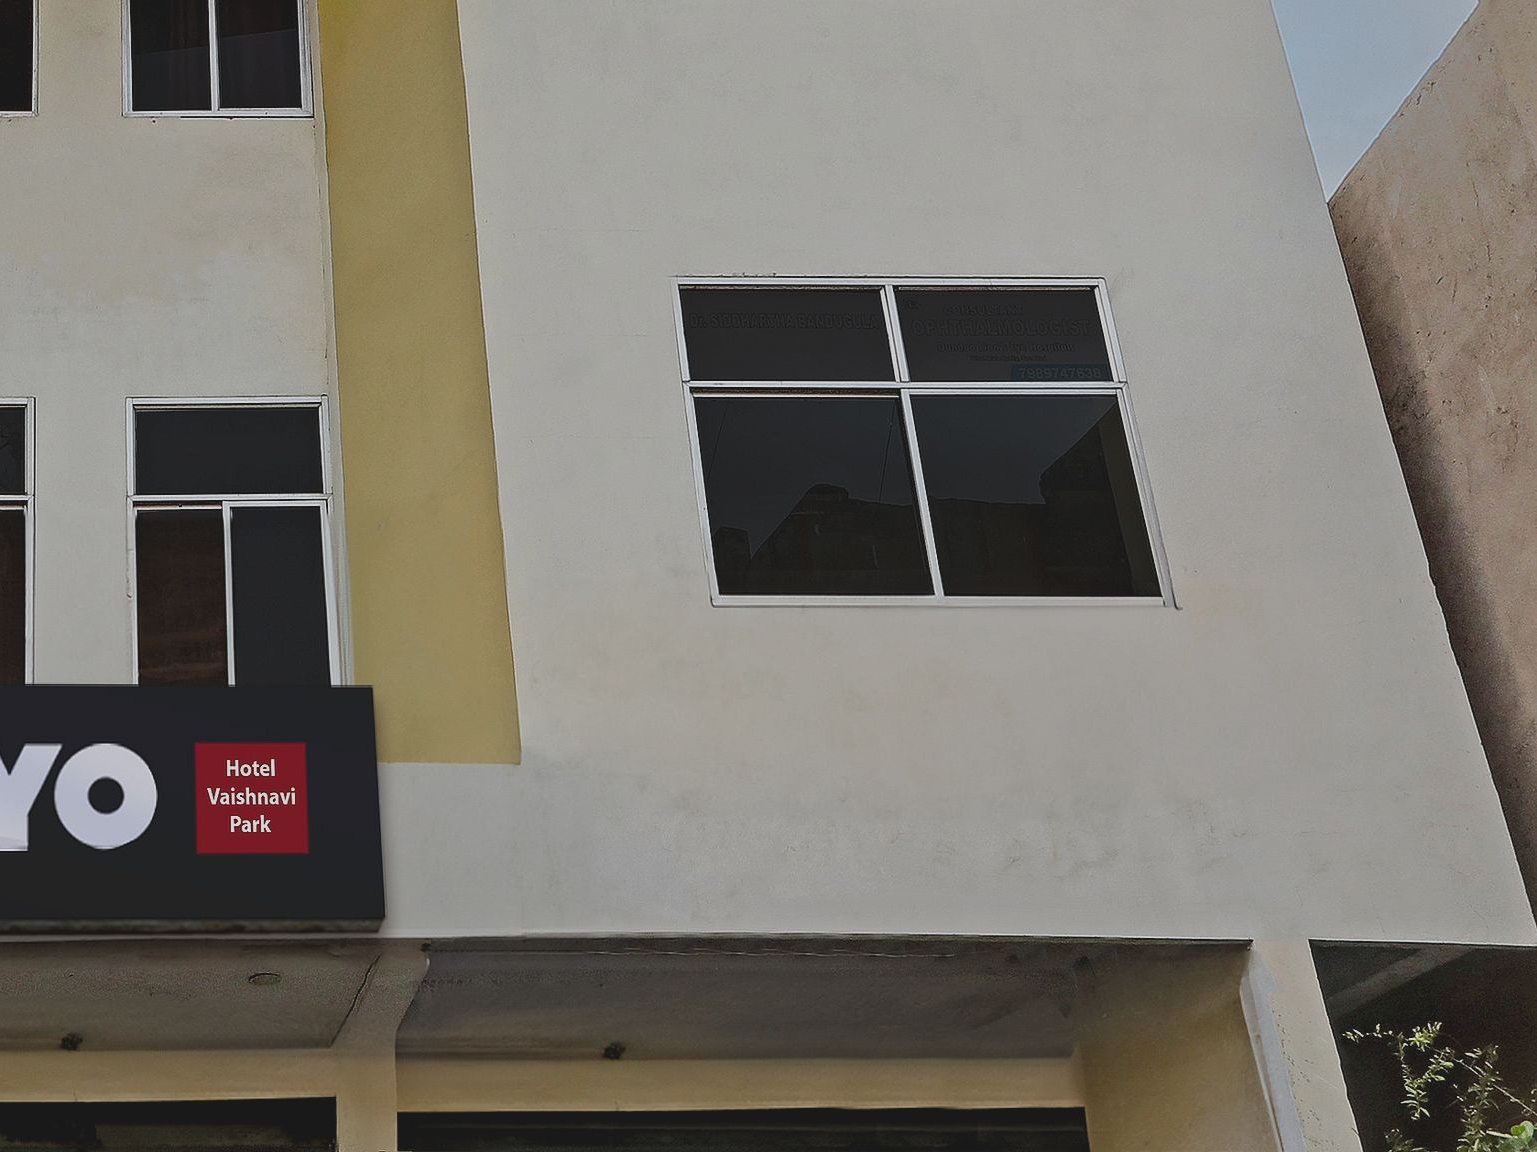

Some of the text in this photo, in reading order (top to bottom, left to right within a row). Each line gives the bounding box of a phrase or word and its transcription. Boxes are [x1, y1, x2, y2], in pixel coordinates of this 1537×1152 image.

[912, 319, 1091, 336] OPHTHALMOLOGIST
[226, 759, 276, 777] Hotel
[207, 787, 296, 805] Vaishnavi
[230, 814, 272, 833] Park
